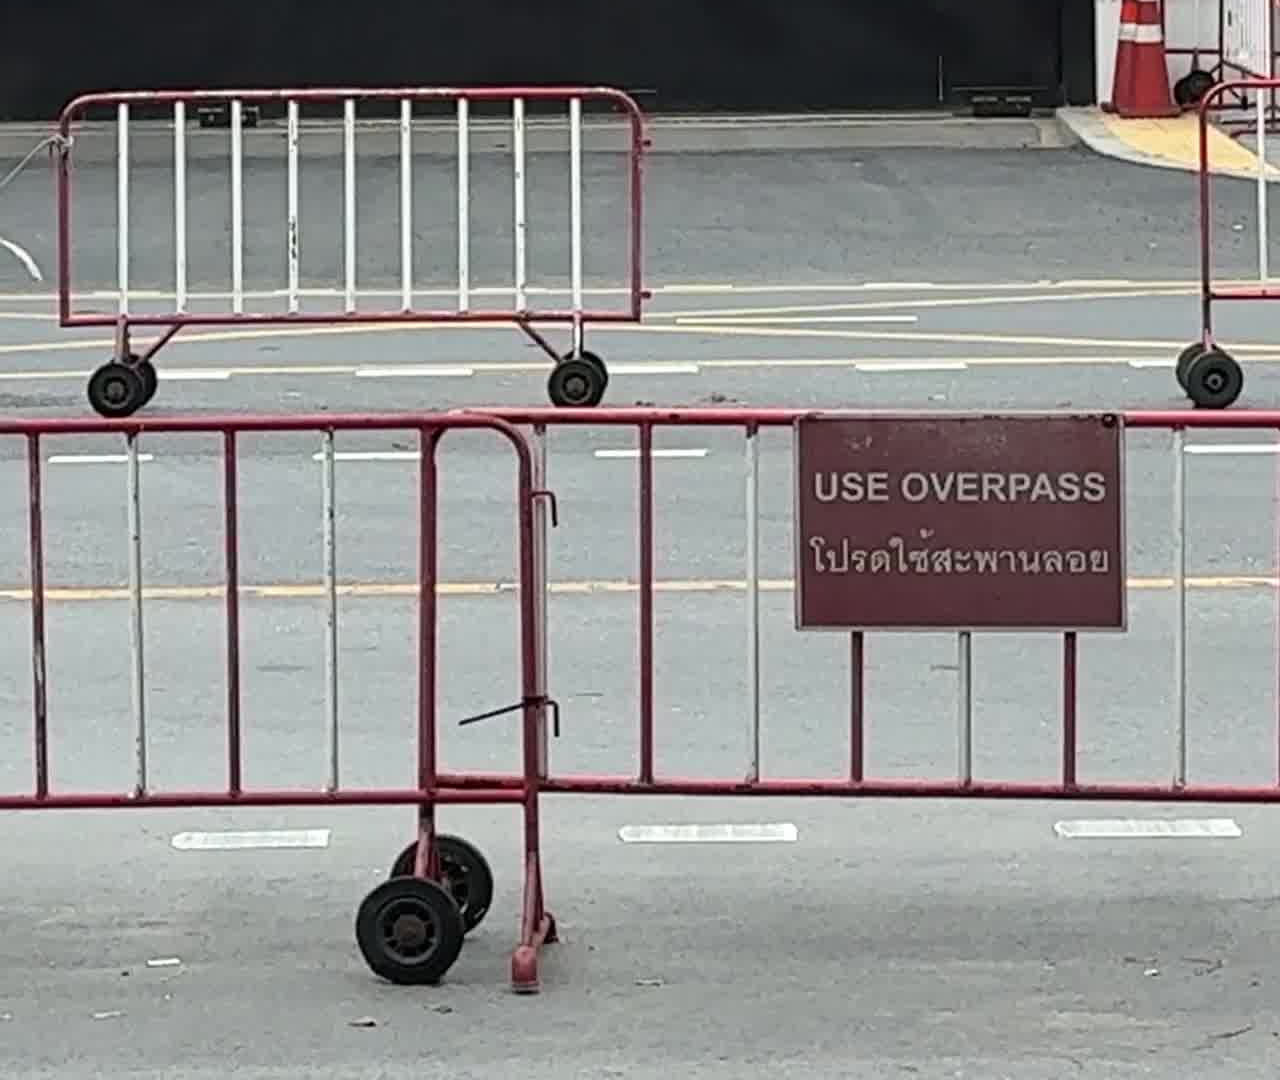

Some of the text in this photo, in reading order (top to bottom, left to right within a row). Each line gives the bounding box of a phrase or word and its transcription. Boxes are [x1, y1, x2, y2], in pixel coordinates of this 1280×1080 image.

[814, 472, 1106, 501] USE OVERPASS
[809, 528, 1109, 573] โปรดใช้สะพานลอย
